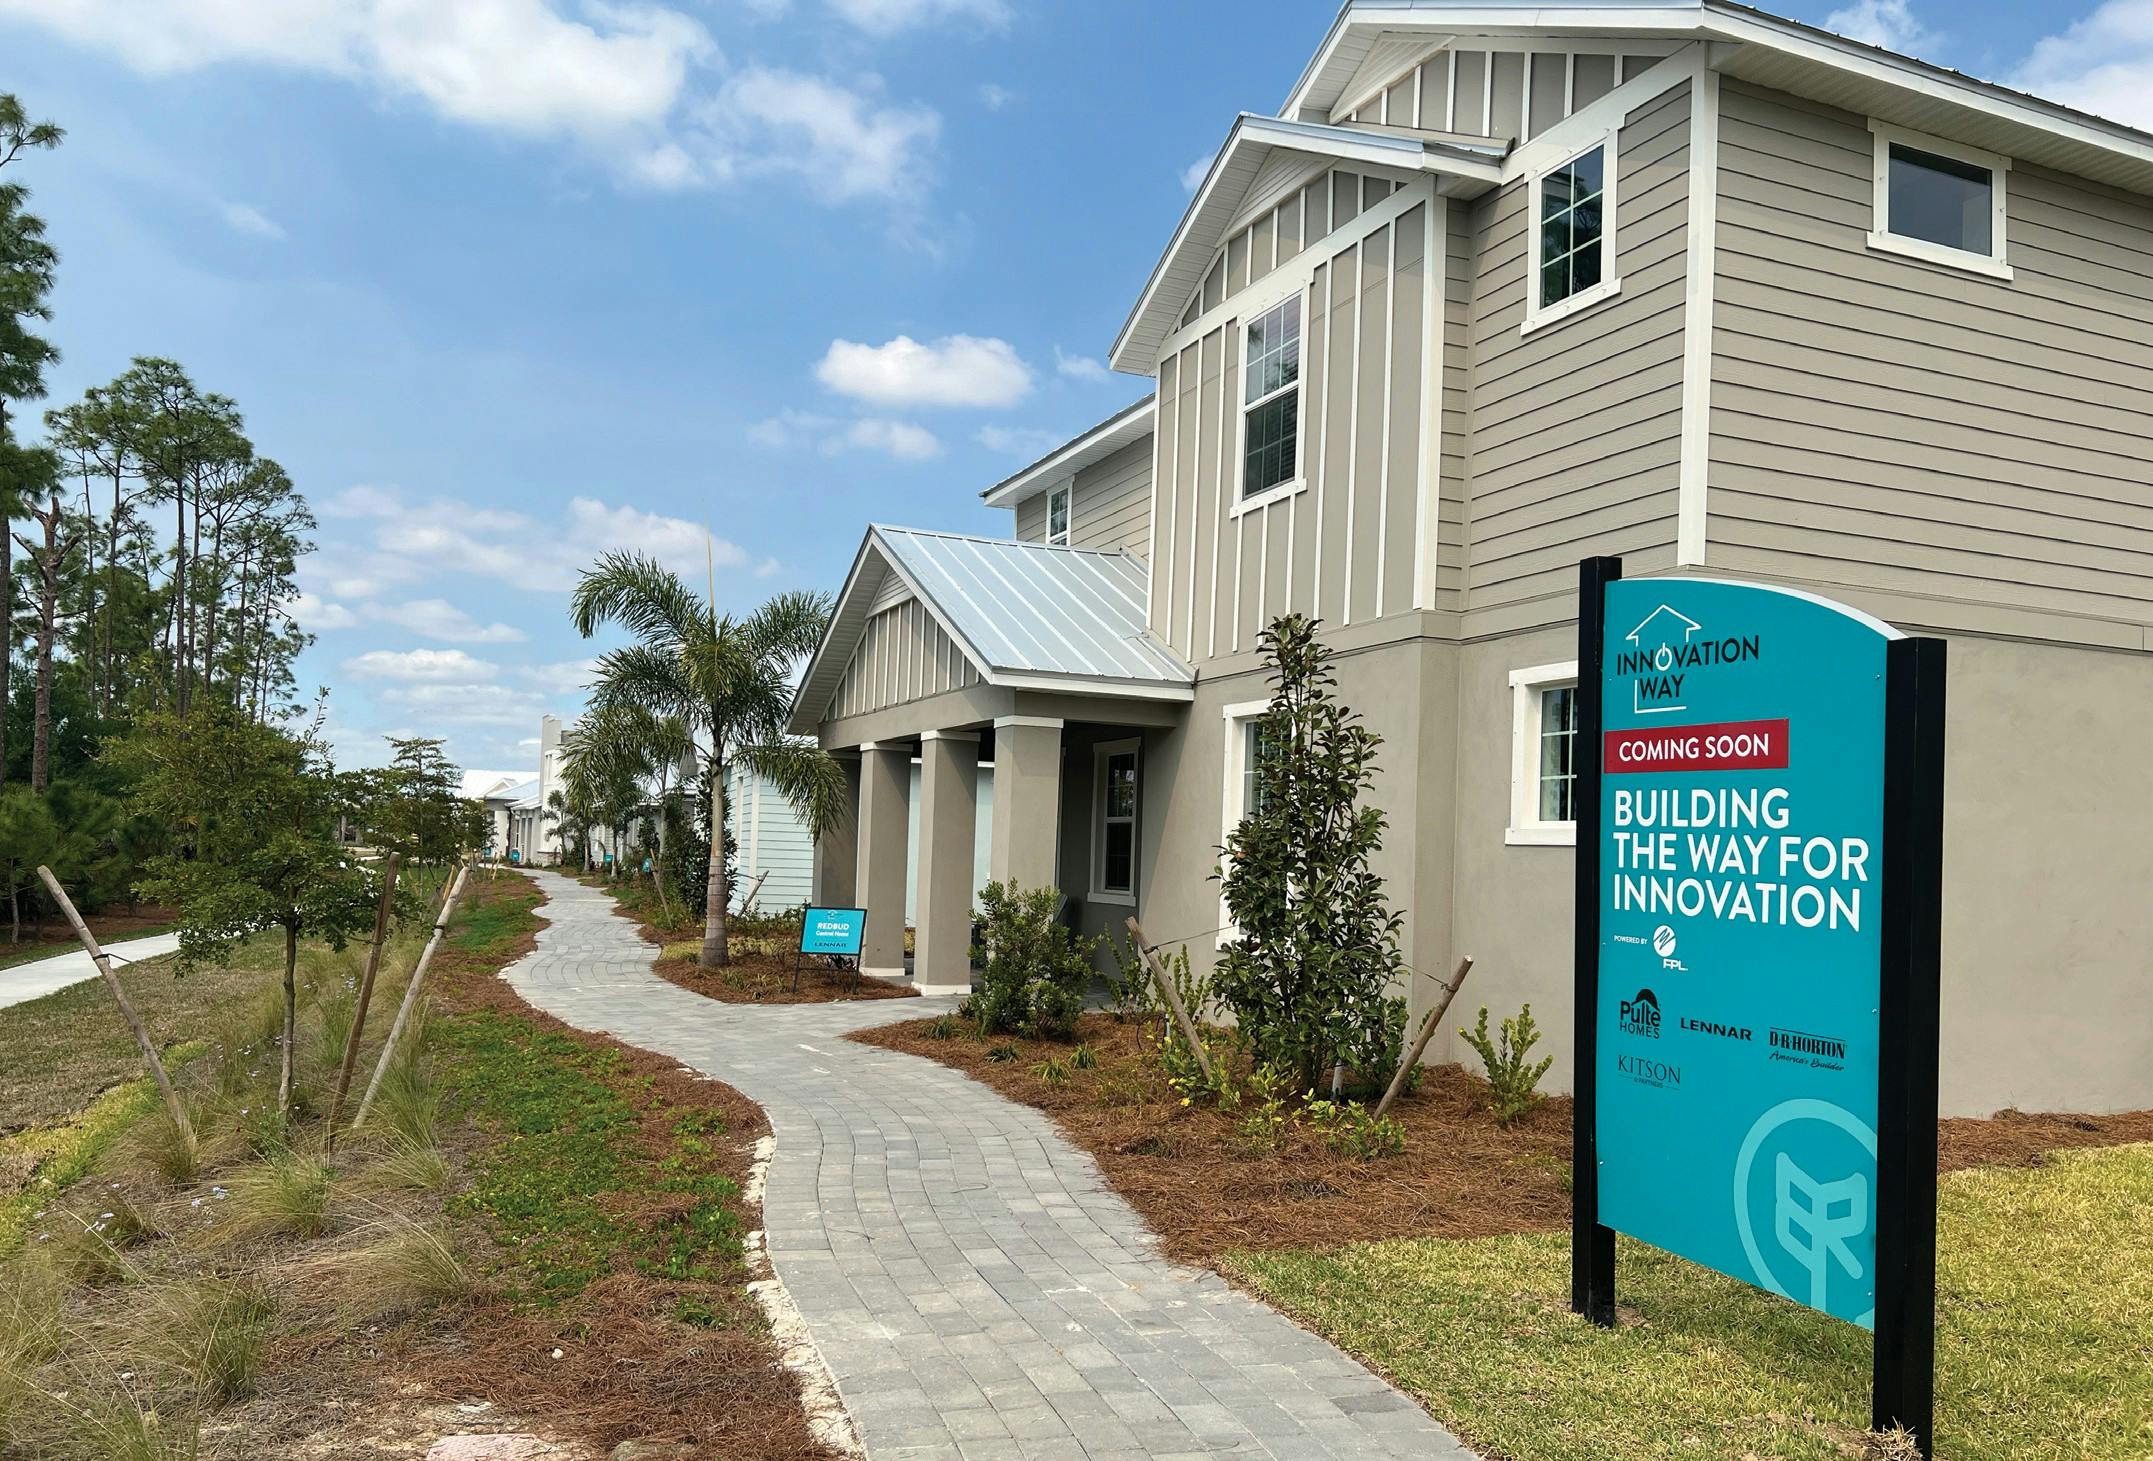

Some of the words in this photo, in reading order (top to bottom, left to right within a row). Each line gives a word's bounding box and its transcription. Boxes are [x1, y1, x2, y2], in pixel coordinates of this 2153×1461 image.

[1617, 635, 1759, 676] INNOVATION
[1639, 674, 1685, 700] WAY
[1619, 737, 1699, 762] COMING
[1705, 733, 1769, 758] SOON
[1614, 788, 1789, 829] BUILDING
[1613, 832, 1677, 871] THE
[1687, 834, 1769, 875] WAY
[1779, 836, 1870, 882] FOR
[1614, 874, 1860, 932] INNOVATION
[1613, 935, 1640, 944] POWERED
[1641, 937, 1648, 945] BY
[1620, 1000, 1661, 1028] Pulte
[1620, 1023, 1660, 1039] HOMES
[1680, 1017, 1752, 1041] LENNAR
[1618, 1054, 1681, 1084] KITSON
[1769, 1050, 1808, 1064] America's
[1810, 1058, 1845, 1072] Builder
